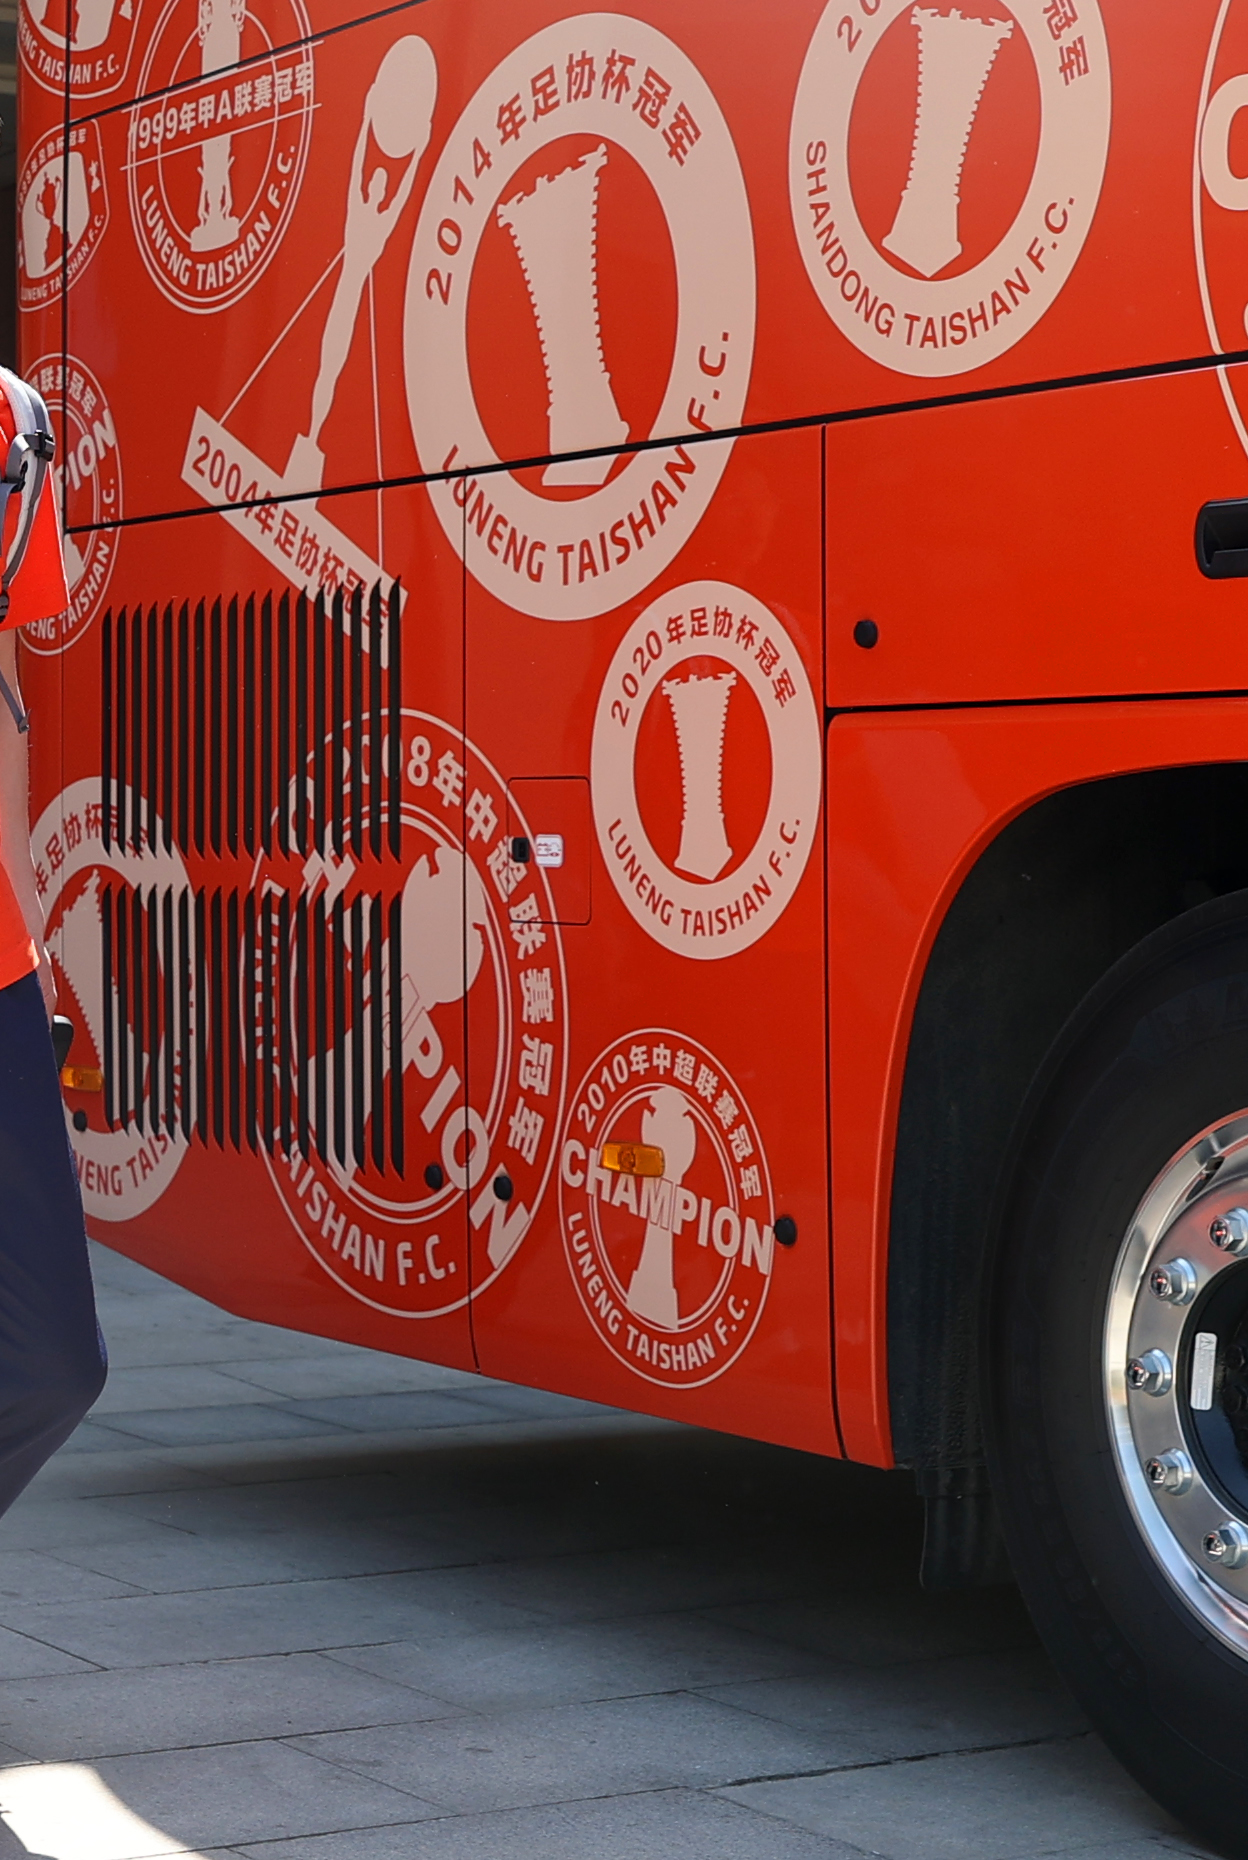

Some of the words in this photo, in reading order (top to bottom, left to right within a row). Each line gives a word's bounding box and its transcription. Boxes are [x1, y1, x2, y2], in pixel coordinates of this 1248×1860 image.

[95, 53, 120, 81] F.C.
[130, 61, 314, 152] 1999年甲A联赛冠军
[87, 213, 105, 243] F.C.
[140, 185, 191, 286] LUNENG
[196, 214, 272, 291] TAISHAN
[267, 144, 297, 210] F.C.
[426, 48, 703, 307] 2014年足协杯冠军
[805, 140, 896, 337] SHANDONG
[903, 267, 1031, 349] TAISHAN
[1025, 197, 1075, 273] F.C.
[441, 444, 547, 583] LUNENG
[557, 444, 697, 586] TAISHAN
[687, 331, 730, 433] F.C.
[58, 541, 111, 635] TAISHAN
[611, 605, 797, 727] 2020年足协杯冠军
[607, 818, 674, 926] LUNENG
[680, 874, 772, 937] TAISHAN
[767, 817, 801, 878] F.C.
[577, 1043, 762, 1201] 2010年中超联赛冠军
[397, 1233, 456, 1286] F.C.
[561, 1138, 774, 1277] CHAMPION
[567, 1212, 623, 1335] LUNENG
[626, 1323, 717, 1373] TAISHAN
[713, 1295, 750, 1347] F.C.
